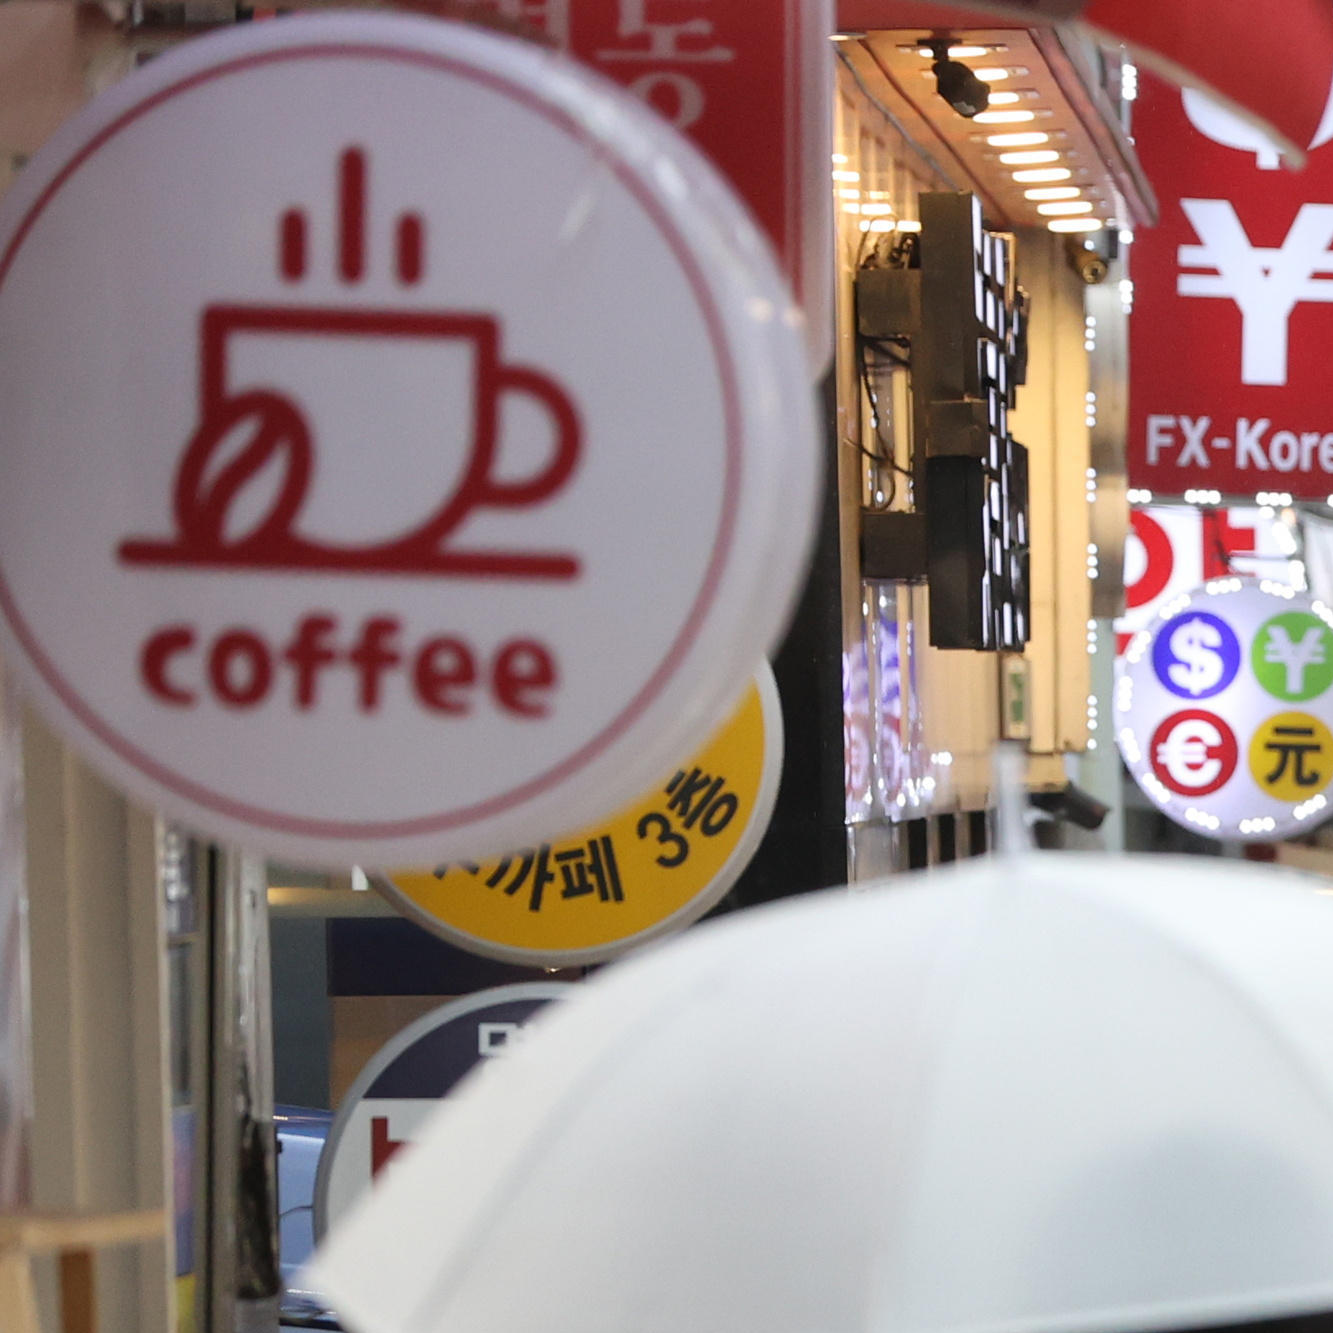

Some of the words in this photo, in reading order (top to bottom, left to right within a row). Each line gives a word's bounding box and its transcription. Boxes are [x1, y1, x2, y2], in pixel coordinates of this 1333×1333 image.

[139, 607, 558, 720] coffee
[1264, 726, 1320, 788] 元
[431, 834, 625, 912] 까페
[635, 765, 741, 870] 3층
